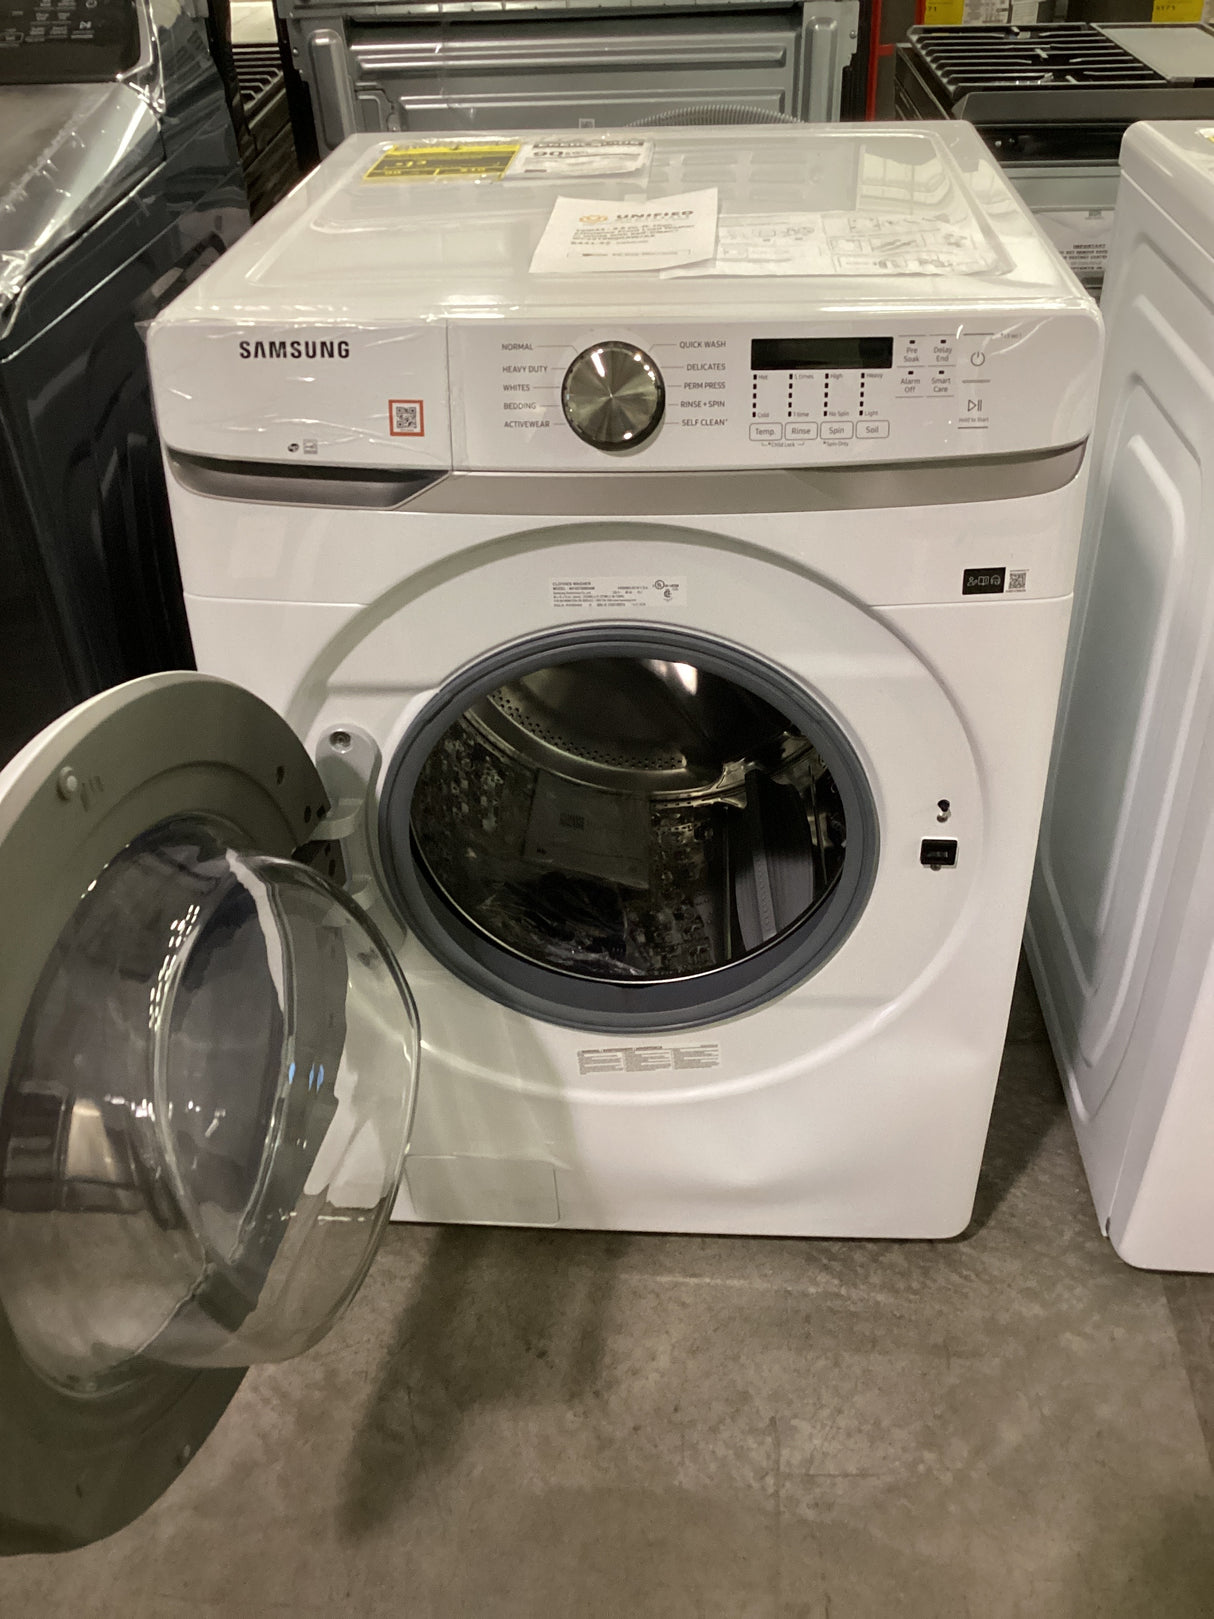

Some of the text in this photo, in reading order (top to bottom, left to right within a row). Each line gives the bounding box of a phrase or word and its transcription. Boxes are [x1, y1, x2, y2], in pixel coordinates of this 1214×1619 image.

[616, 210, 694, 220] UNIFIED
[501, 343, 533, 351] NORMAL
[679, 341, 726, 349] QUICK WASH
[239, 340, 350, 359] SAMSUNG
[933, 346, 952, 354] Delay
[528, 365, 548, 373] DUTY
[686, 363, 726, 371] DELICATES
[503, 384, 530, 392] WHITES
[684, 382, 703, 390] PERM
[504, 402, 536, 410] BEDDING
[504, 420, 550, 428] ACTIVEWEAR
[791, 427, 811, 435] Rinse
[828, 426, 845, 435] Spin
[865, 425, 880, 434] Soil
